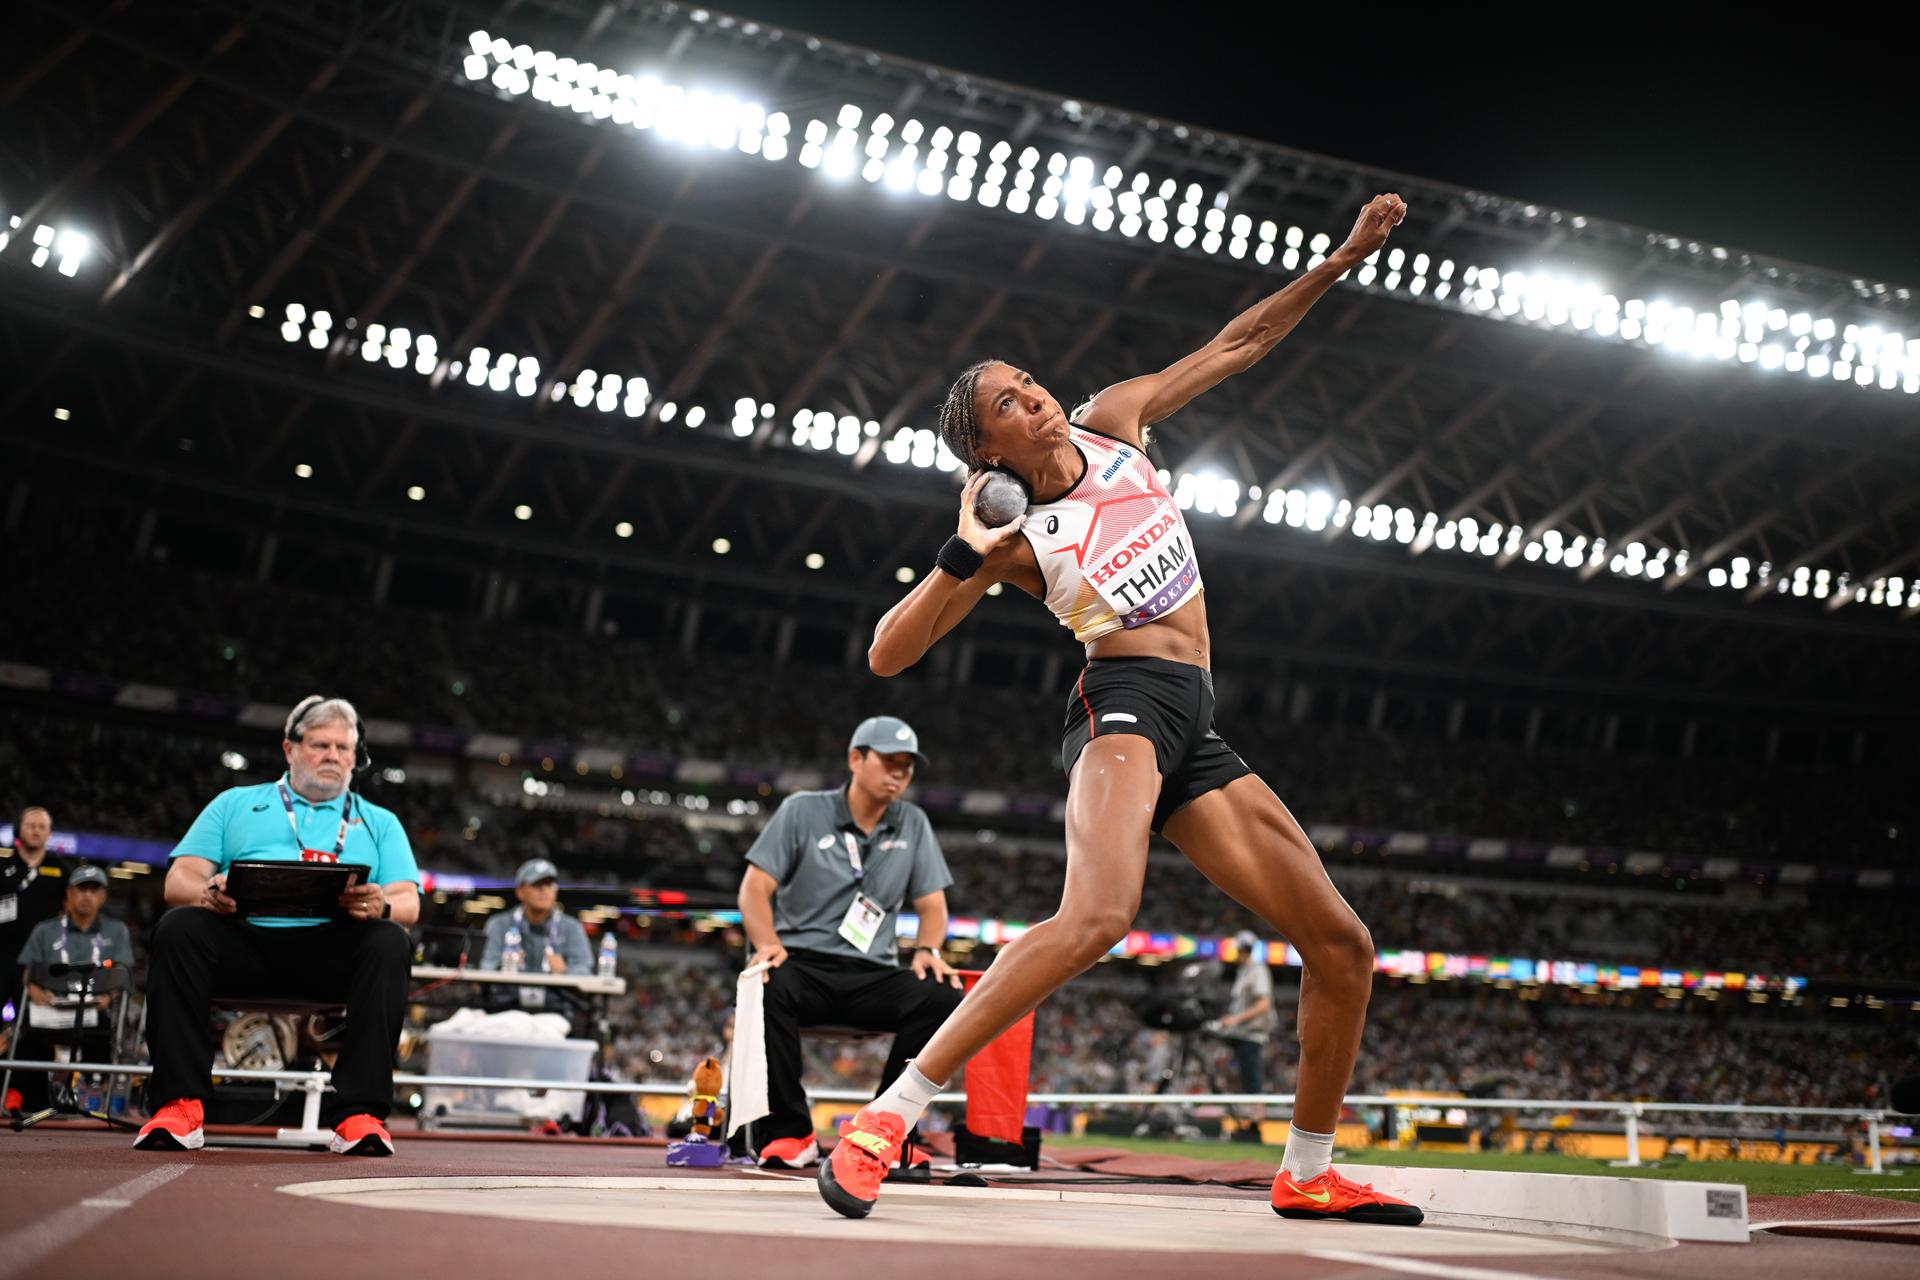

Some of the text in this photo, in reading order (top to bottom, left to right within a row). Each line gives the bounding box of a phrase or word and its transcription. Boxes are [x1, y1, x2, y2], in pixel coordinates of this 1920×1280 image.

[1102, 456, 1125, 482] Allianz
[1090, 514, 1176, 587] HONDA
[1111, 536, 1187, 607] THIAM
[845, 1129, 891, 1155] NIKE
